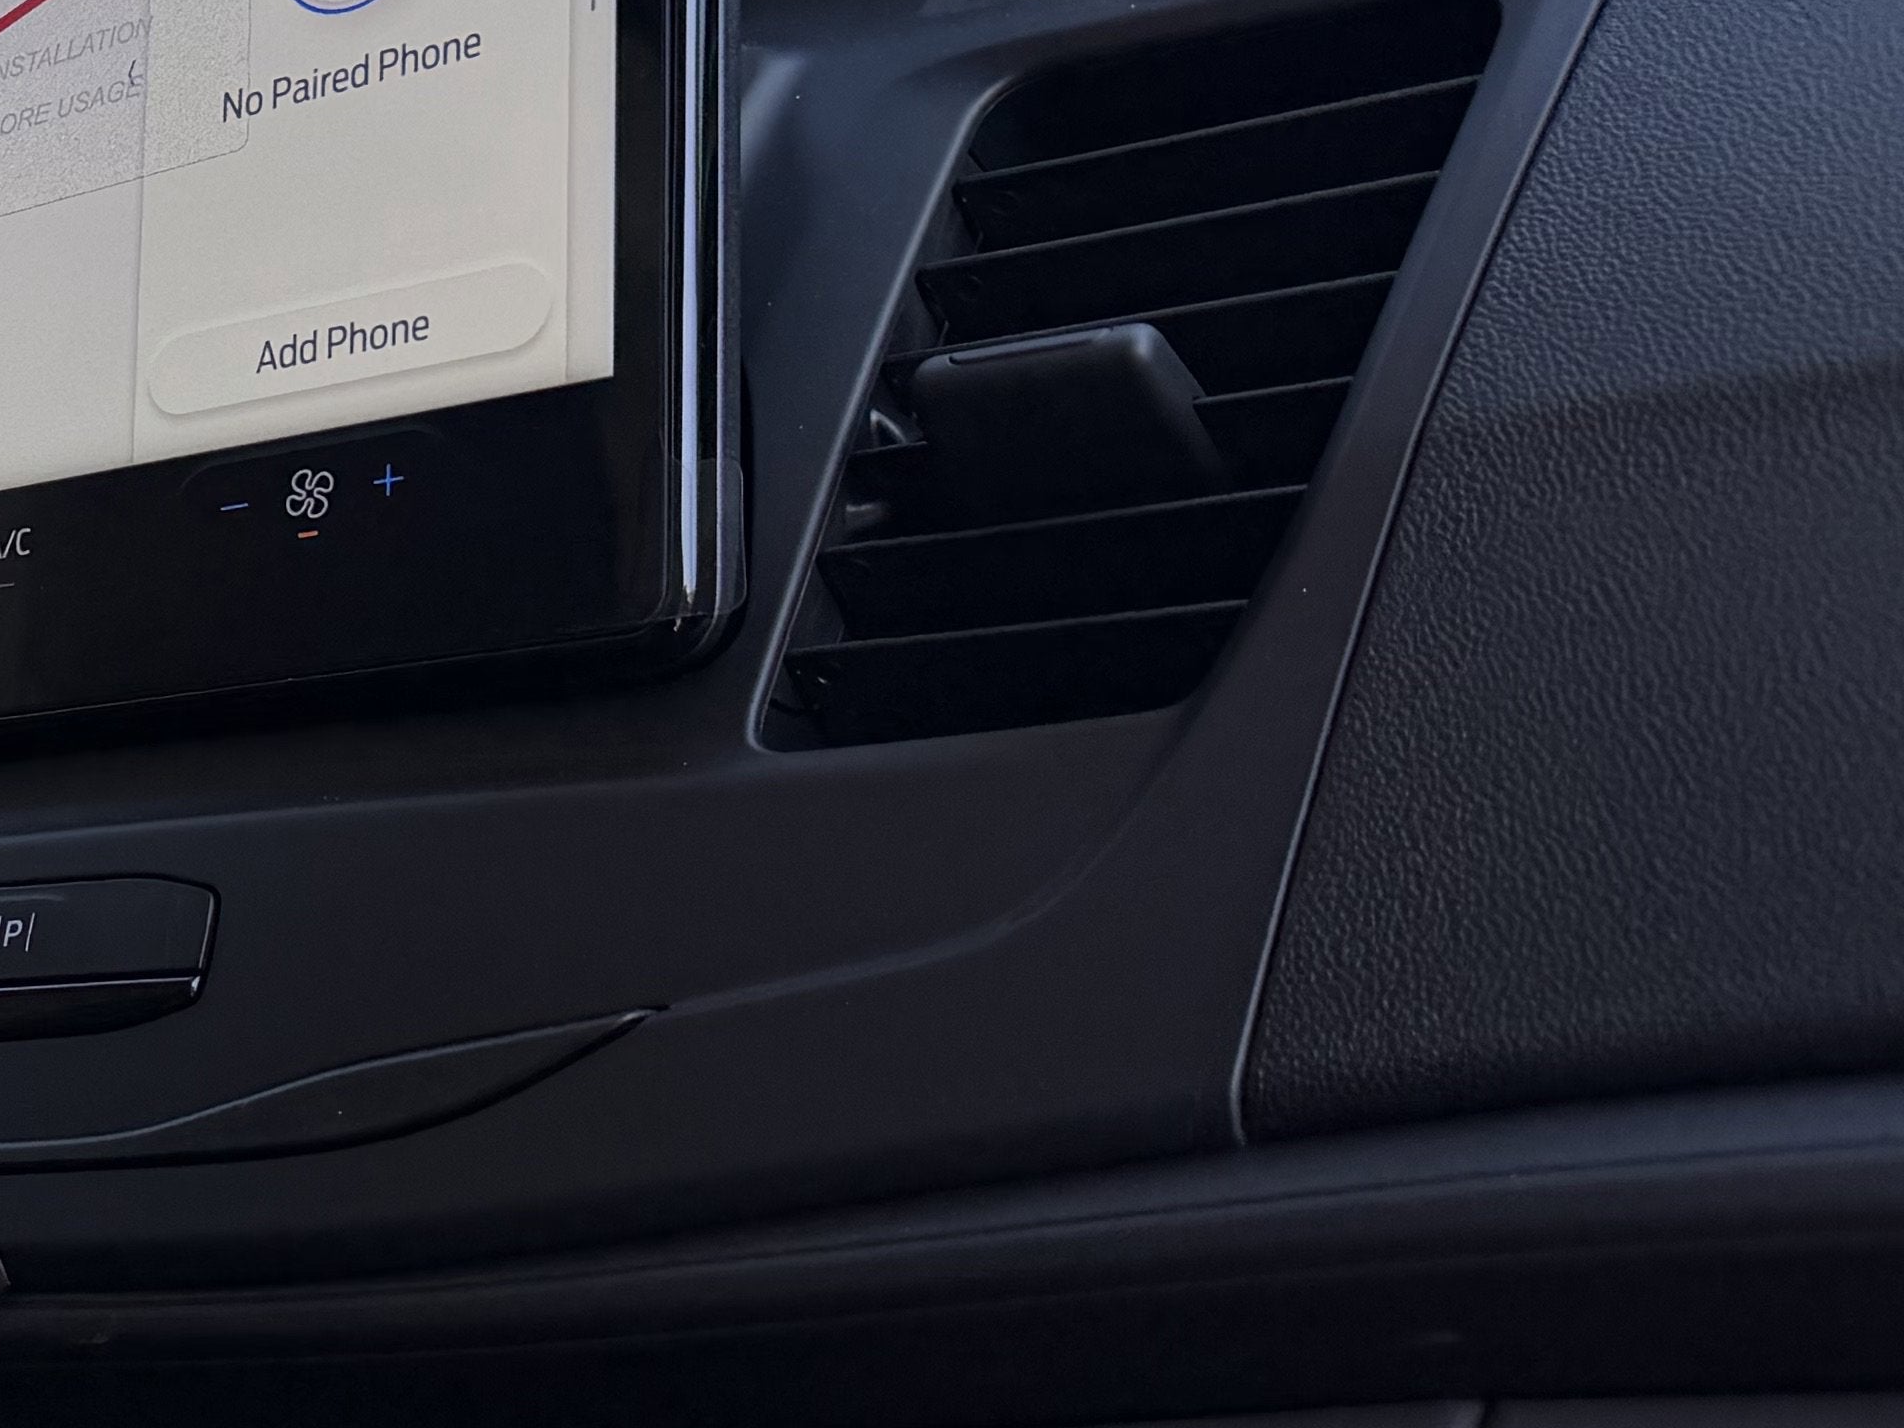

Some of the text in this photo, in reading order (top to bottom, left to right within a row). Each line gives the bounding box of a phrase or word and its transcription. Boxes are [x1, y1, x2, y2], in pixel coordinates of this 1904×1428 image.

[57, 74, 145, 119] USAGE
[222, 32, 482, 123] No Paired Phone
[255, 314, 430, 374] Add Phone
